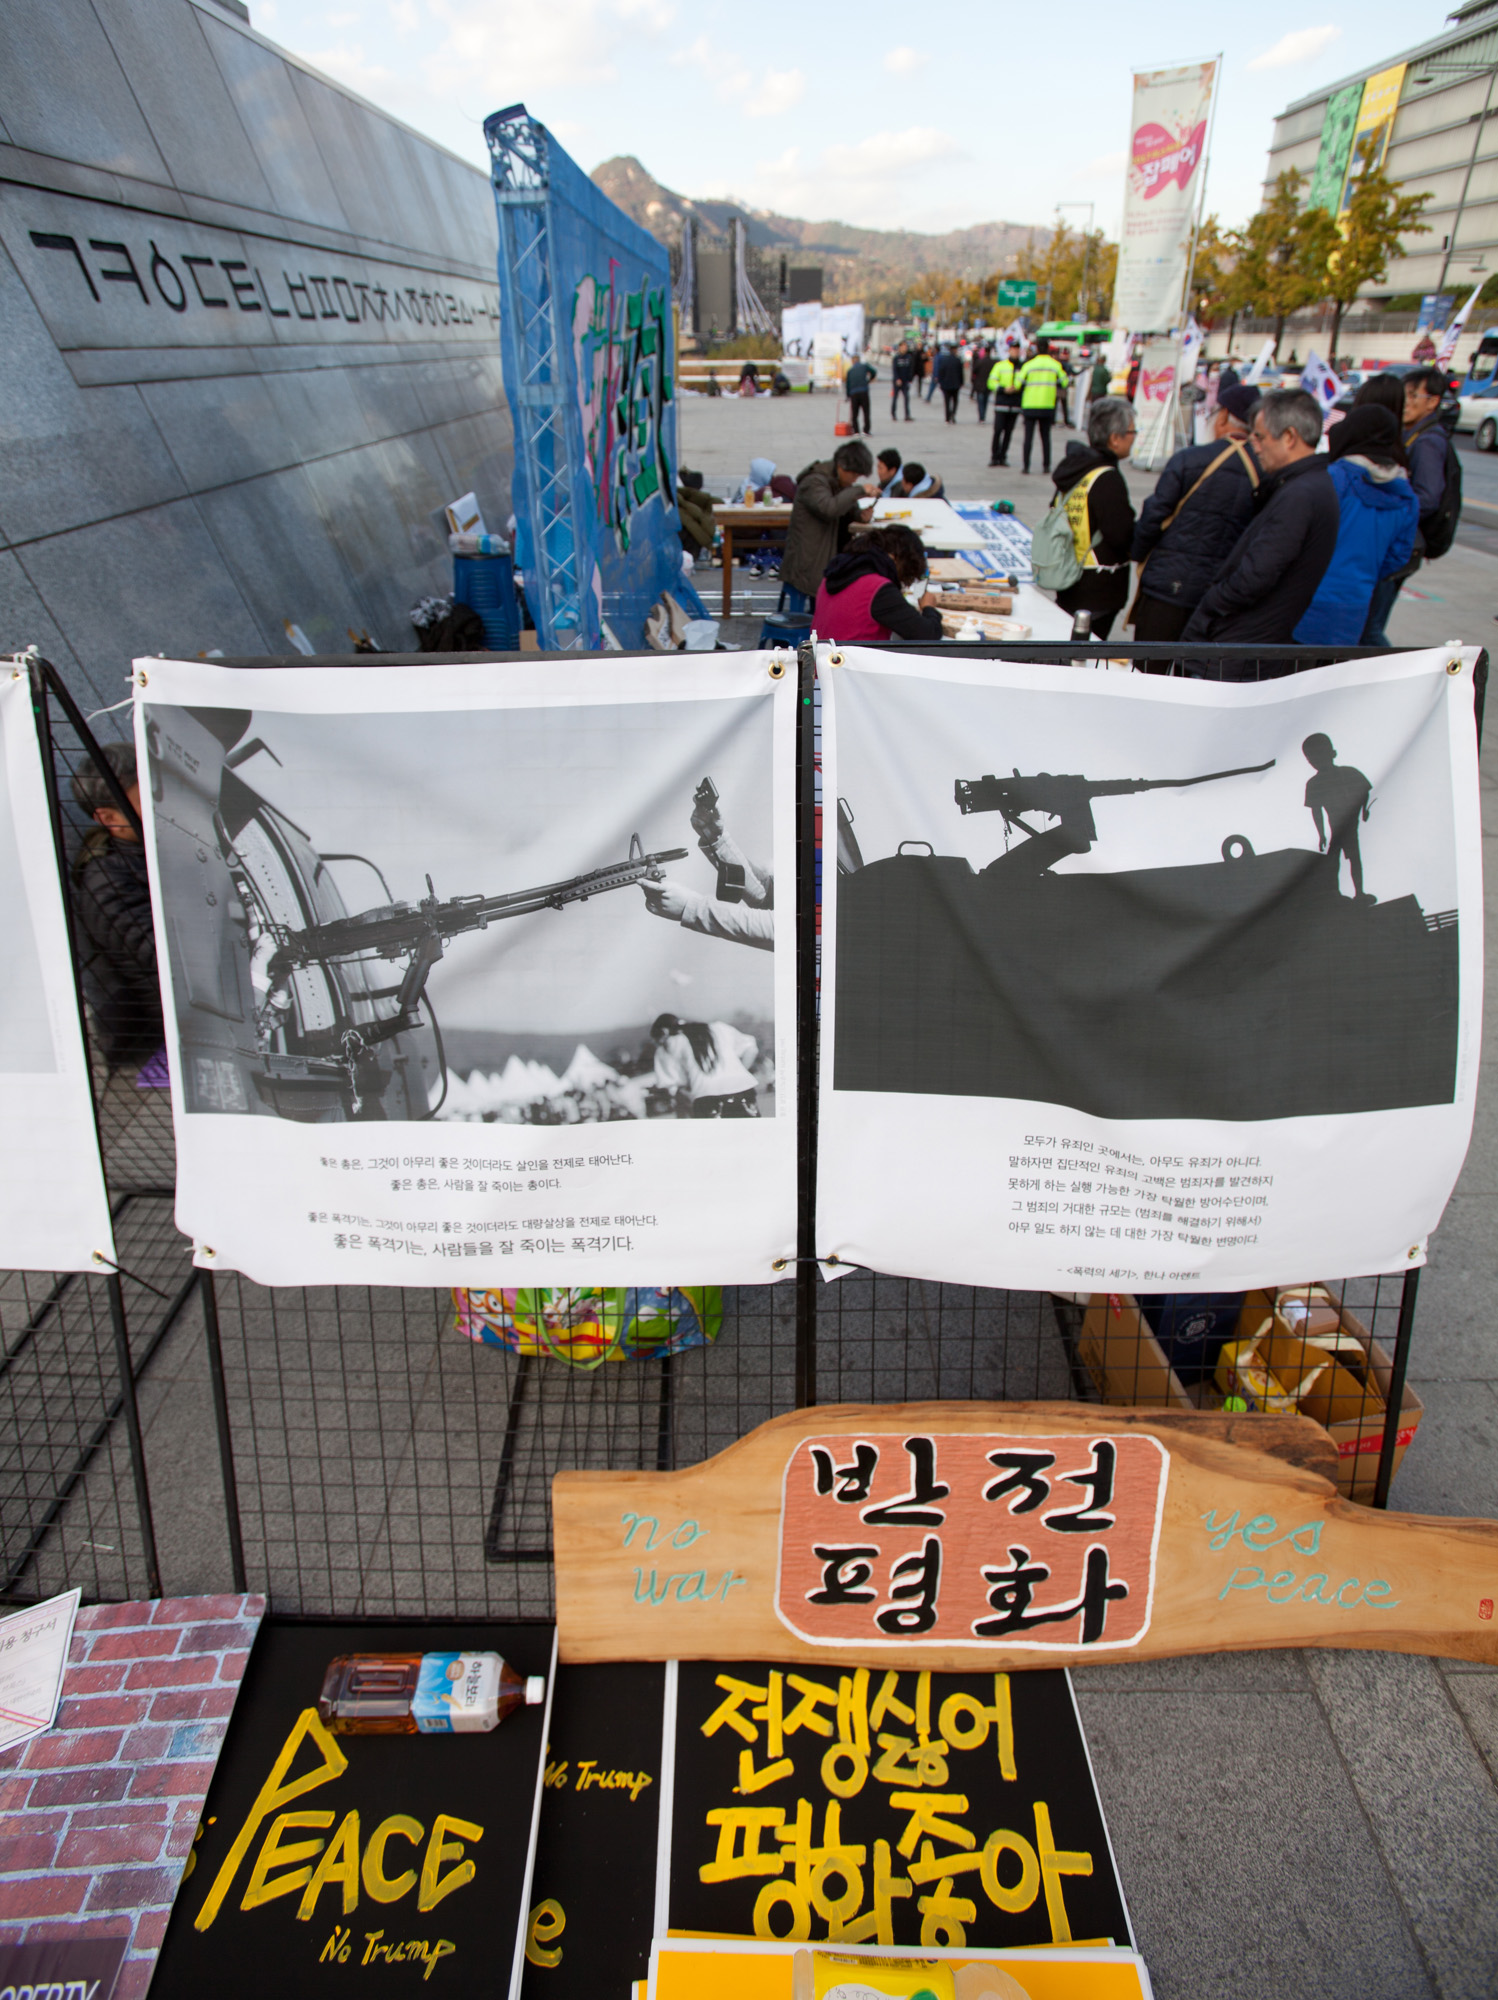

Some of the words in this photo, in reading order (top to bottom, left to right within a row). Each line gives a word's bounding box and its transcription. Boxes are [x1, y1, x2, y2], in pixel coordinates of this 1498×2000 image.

[319, 1156, 338, 1169] 좋은
[340, 1158, 364, 1171] 총은,
[367, 1156, 400, 1171] 그것이
[402, 1156, 435, 1169] 아무리
[438, 1156, 460, 1170] 좋은
[462, 1157, 514, 1172] 것이더라도
[515, 1158, 550, 1173] 살인을
[552, 1156, 586, 1170] 전제로
[588, 1153, 634, 1167] 태어난다.
[1023, 1134, 1058, 1149] 모두가
[1060, 1137, 1095, 1153] 유죄인
[1149, 1155, 1185, 1168] 아무도
[1187, 1156, 1224, 1169] 유죄가
[1225, 1155, 1262, 1169] 아니다.
[389, 1178, 413, 1192] 좋은
[415, 1177, 441, 1191] 총은,
[443, 1178, 475, 1192] 사람을
[477, 1180, 489, 1193] 잘
[491, 1180, 524, 1193] 죽이는
[526, 1177, 562, 1192] 총이다.
[1008, 1155, 1053, 1170] 말하자면
[1056, 1157, 1101, 1174] 집단적인
[1104, 1164, 1139, 1182] 유죄의
[1141, 1174, 1177, 1189] 고백은
[1179, 1176, 1226, 1189] 범죄자를
[1228, 1175, 1274, 1188] 발견하지
[1007, 1177, 1041, 1192] 못하게
[1043, 1178, 1067, 1193] 하는
[1069, 1180, 1093, 1194] 실행
[1095, 1182, 1131, 1197] 가능한
[1133, 1188, 1159, 1203] 가장
[1161, 1195, 1197, 1209] 탁월한
[1199, 1195, 1269, 1209] 방어수단이며,
[307, 1211, 329, 1224] 좋은
[375, 1218, 404, 1232] 그것이
[405, 1221, 438, 1234] 아무리
[441, 1221, 463, 1234] 좋은
[466, 1220, 520, 1234] 것이더라도
[521, 1216, 576, 1230] 대량살상을
[578, 1215, 612, 1228] 전제로
[613, 1214, 659, 1227] 태어난다.
[1011, 1200, 1024, 1212] 그
[1026, 1200, 1059, 1215] 범죄의
[1062, 1202, 1096, 1216] 거대한
[1098, 1204, 1132, 1218] 규모는
[1134, 1207, 1174, 1223] (범죄를
[1176, 1215, 1222, 1229] 해결하기
[1225, 1215, 1263, 1228] 위해서)
[333, 1233, 363, 1250] 좋은
[432, 1240, 494, 1258] 사람들을
[498, 1239, 515, 1256] 잘
[519, 1237, 566, 1254] 죽이는
[570, 1235, 635, 1254] 폭격기다.
[1008, 1221, 1031, 1234] 아무
[1033, 1222, 1056, 1235] 일도
[1059, 1223, 1081, 1237] 하지
[1084, 1224, 1107, 1239] 않는
[1109, 1226, 1122, 1240] 데
[1124, 1227, 1148, 1241] 대한
[1150, 1228, 1175, 1243] 가장
[1177, 1232, 1213, 1248] 탁월한
[1066, 1265, 1106, 1278] <폭력의
[1108, 1268, 1139, 1281] 세기>,
[1143, 1270, 1166, 1281] 한나
[621, 1511, 707, 1551] no
[632, 1566, 746, 1606] war
[807, 1536, 1130, 1645] 평화
[1219, 1566, 1401, 1610] peace
[21, 1617, 57, 1643] 청구서
[575, 1760, 653, 1803] Trump
[193, 1707, 484, 1933] PEACE
[319, 1925, 350, 1965] No
[362, 1929, 457, 1981] Trump
